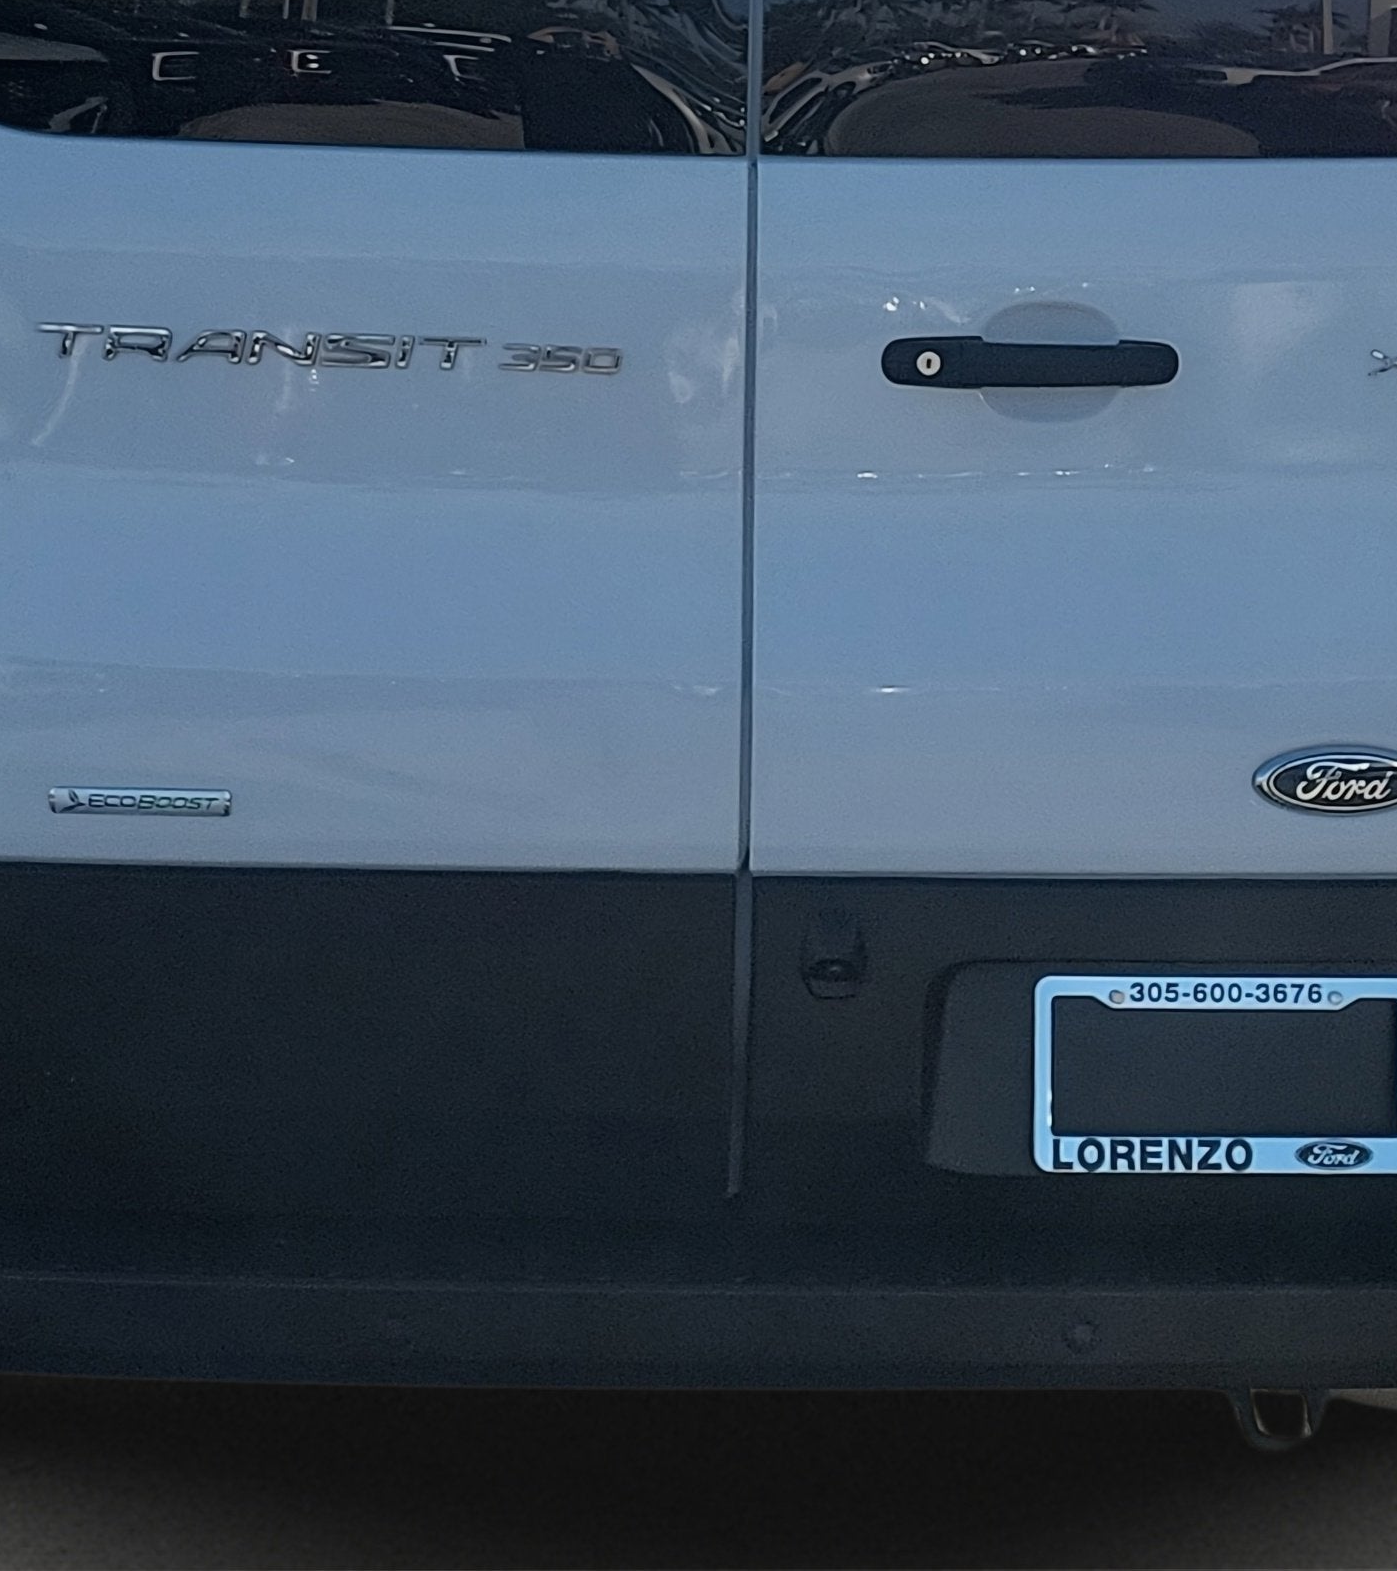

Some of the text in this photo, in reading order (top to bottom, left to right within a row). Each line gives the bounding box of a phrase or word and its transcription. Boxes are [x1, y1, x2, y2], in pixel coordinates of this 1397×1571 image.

[35, 321, 622, 374] TRANSIT 350
[1295, 760, 1394, 802] Ford
[87, 792, 220, 812] ECOBOOST
[1128, 981, 1324, 1005] 305-600-3676
[1052, 1137, 1362, 1173] LORENZO Ford
